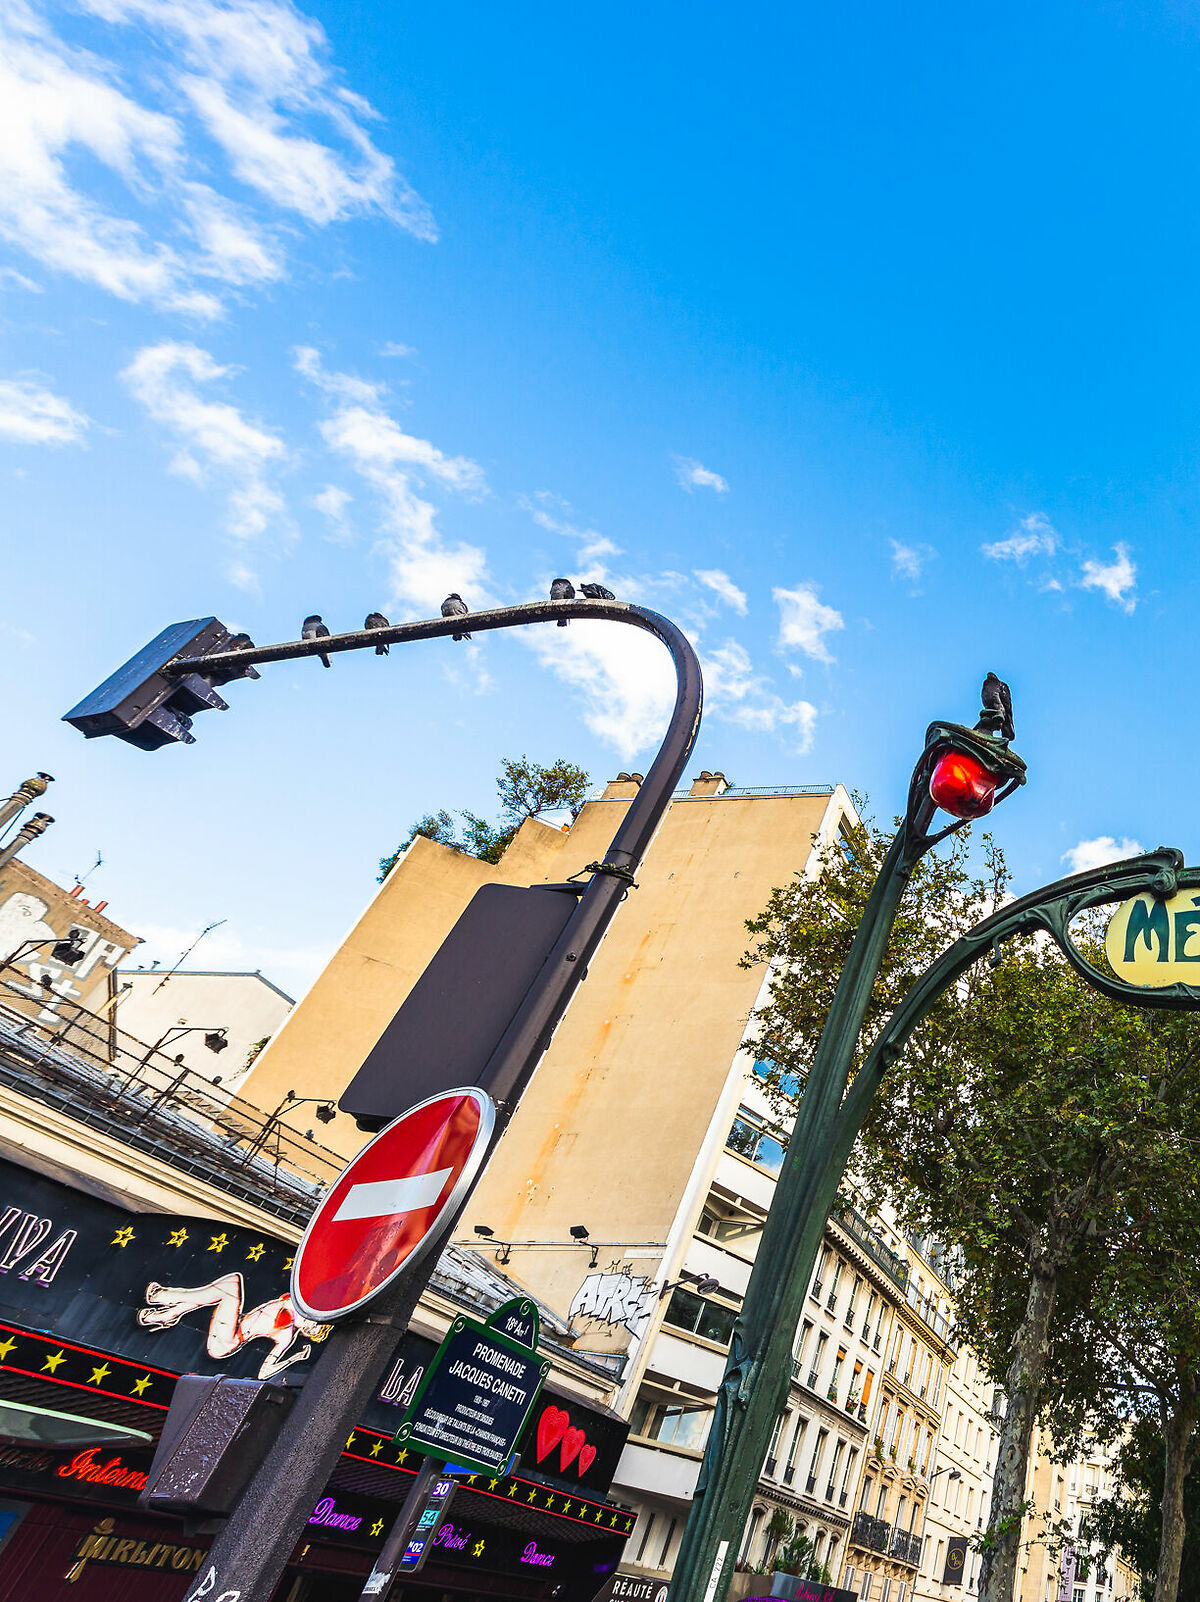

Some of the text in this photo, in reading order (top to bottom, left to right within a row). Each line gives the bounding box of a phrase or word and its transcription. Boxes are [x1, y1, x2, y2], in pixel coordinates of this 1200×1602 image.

[472, 1342, 527, 1379] PROMENADE
[448, 1360, 492, 1390] JACQUES
[493, 1379, 527, 1406] CANETTI
[433, 1482, 450, 1495] 30
[308, 1497, 555, 1567] Dance Privé Dance
[419, 1511, 436, 1524] 54
[77, 1534, 208, 1571] MIRLITON
